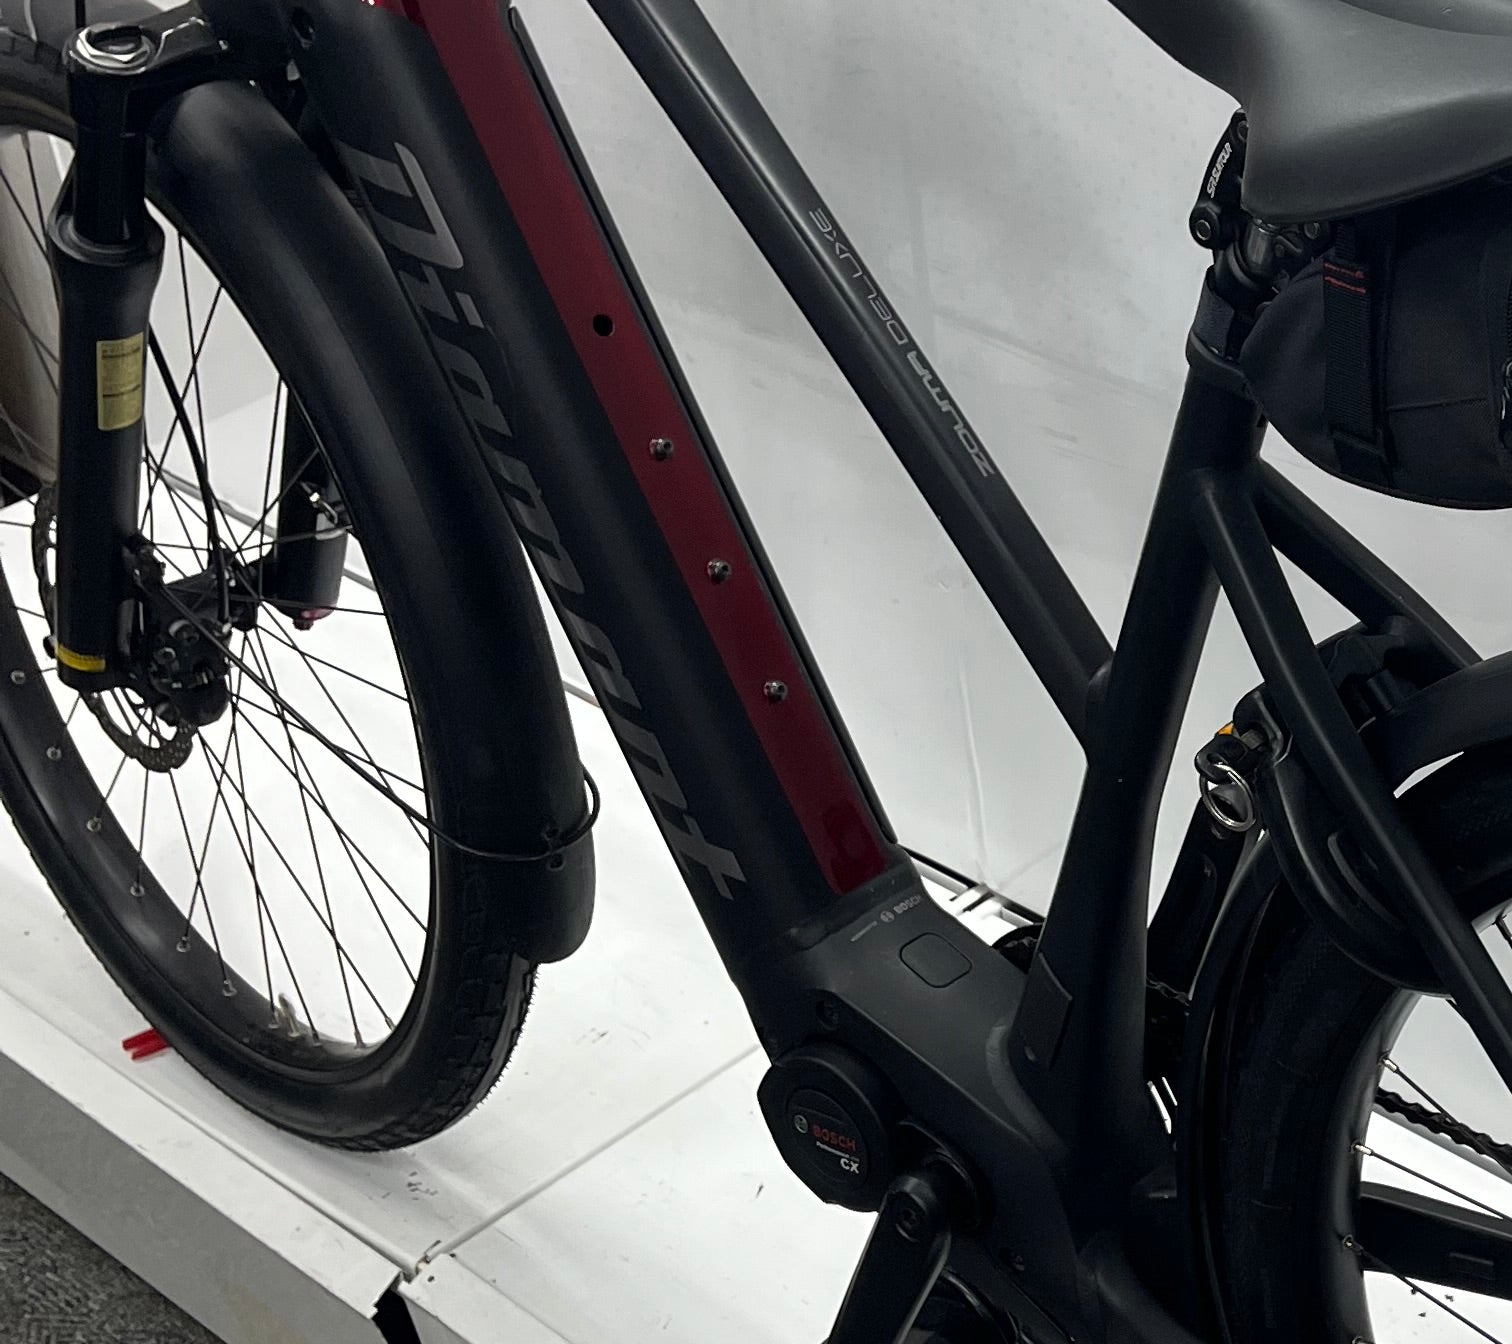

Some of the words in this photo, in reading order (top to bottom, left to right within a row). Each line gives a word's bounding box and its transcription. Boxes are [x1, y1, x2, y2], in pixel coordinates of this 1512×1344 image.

[808, 207, 910, 346] DELUXE
[906, 349, 996, 478] ZOUMA
[336, 139, 747, 901] Diamant
[811, 1125, 857, 1152] BOSCH
[839, 1157, 860, 1175] CX
